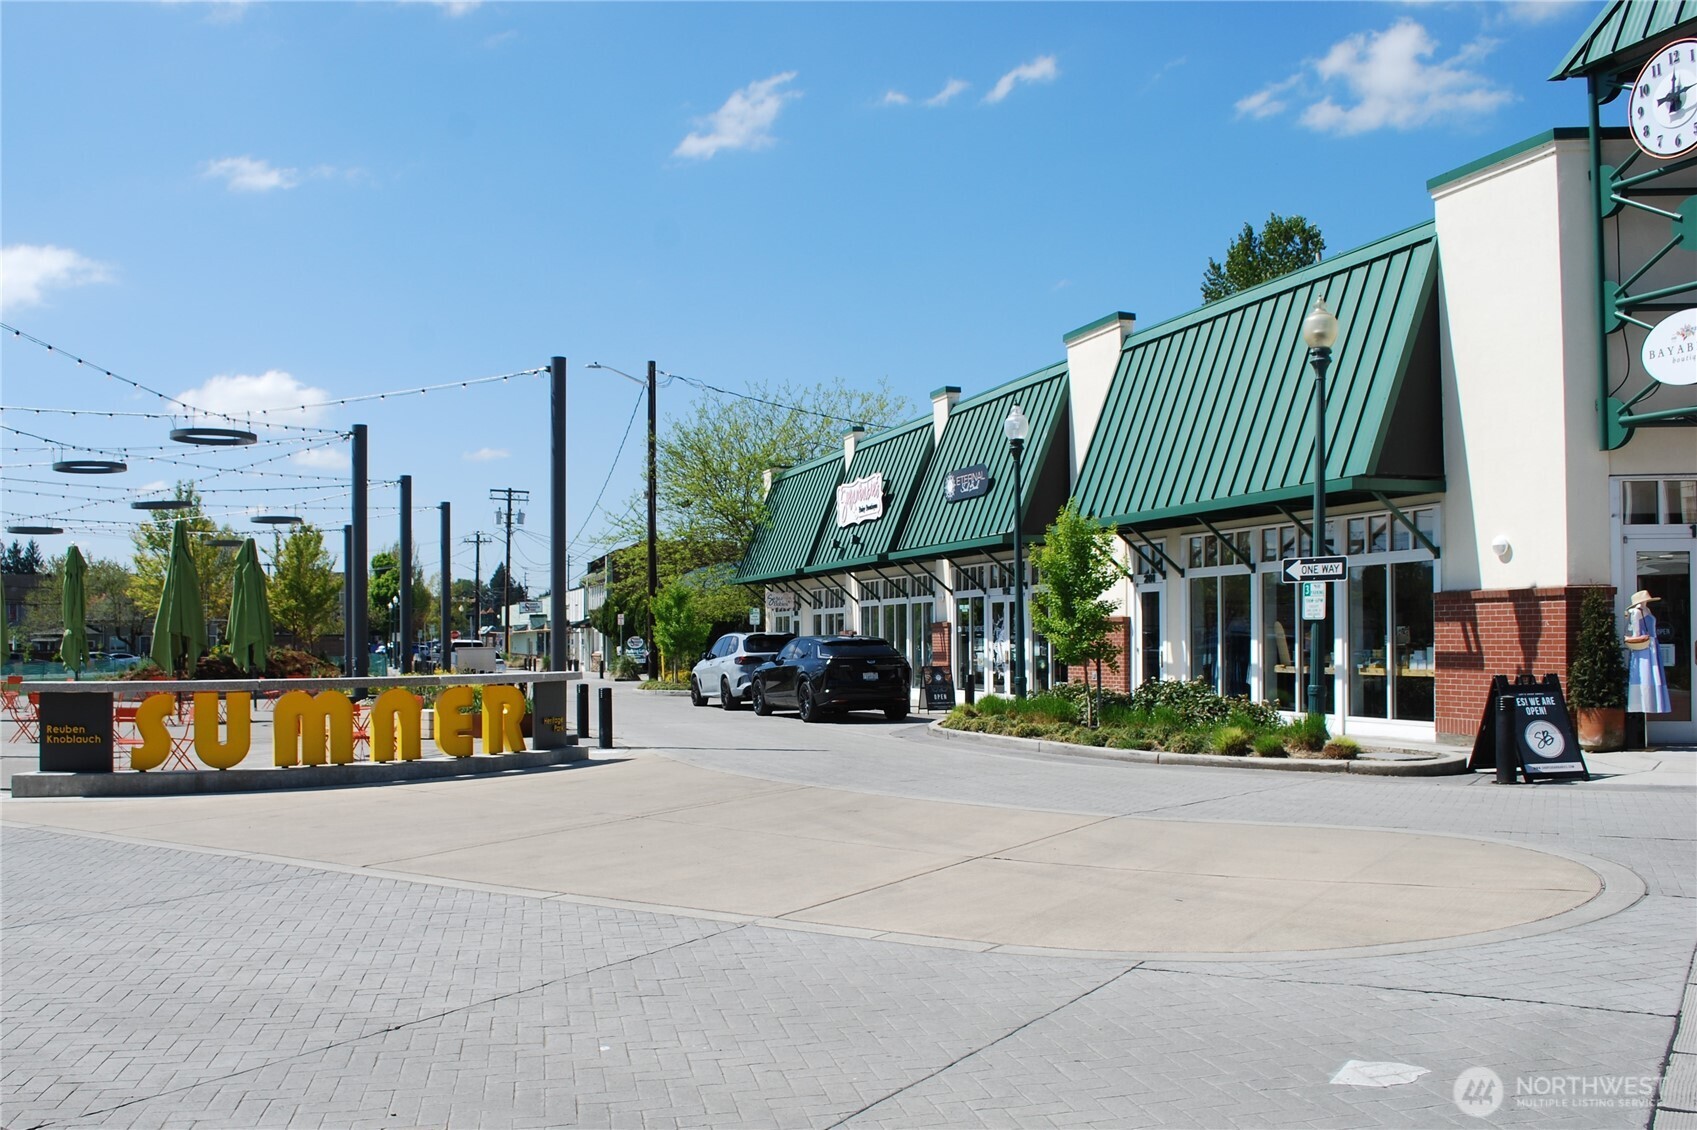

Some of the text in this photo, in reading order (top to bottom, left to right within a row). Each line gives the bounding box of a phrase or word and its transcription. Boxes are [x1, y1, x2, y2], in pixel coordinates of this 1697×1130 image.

[1669, 50, 1680, 65] 12
[1652, 63, 1662, 78] 11
[1640, 83, 1651, 98] 10
[1637, 106, 1645, 118] 9
[1643, 125, 1651, 138] 8
[1657, 135, 1664, 148] 7
[1675, 134, 1682, 147] 6
[1649, 343, 1697, 359] BAYAB
[956, 471, 985, 485] ETERNAL
[1301, 564, 1340, 574] ONE WAY
[1515, 696, 1556, 706] ES! WE ARE
[1525, 706, 1547, 715] OPEN!
[46, 724, 86, 734] Reuben
[131, 686, 527, 770] SUMNER
[46, 734, 102, 744] Knoblauch
